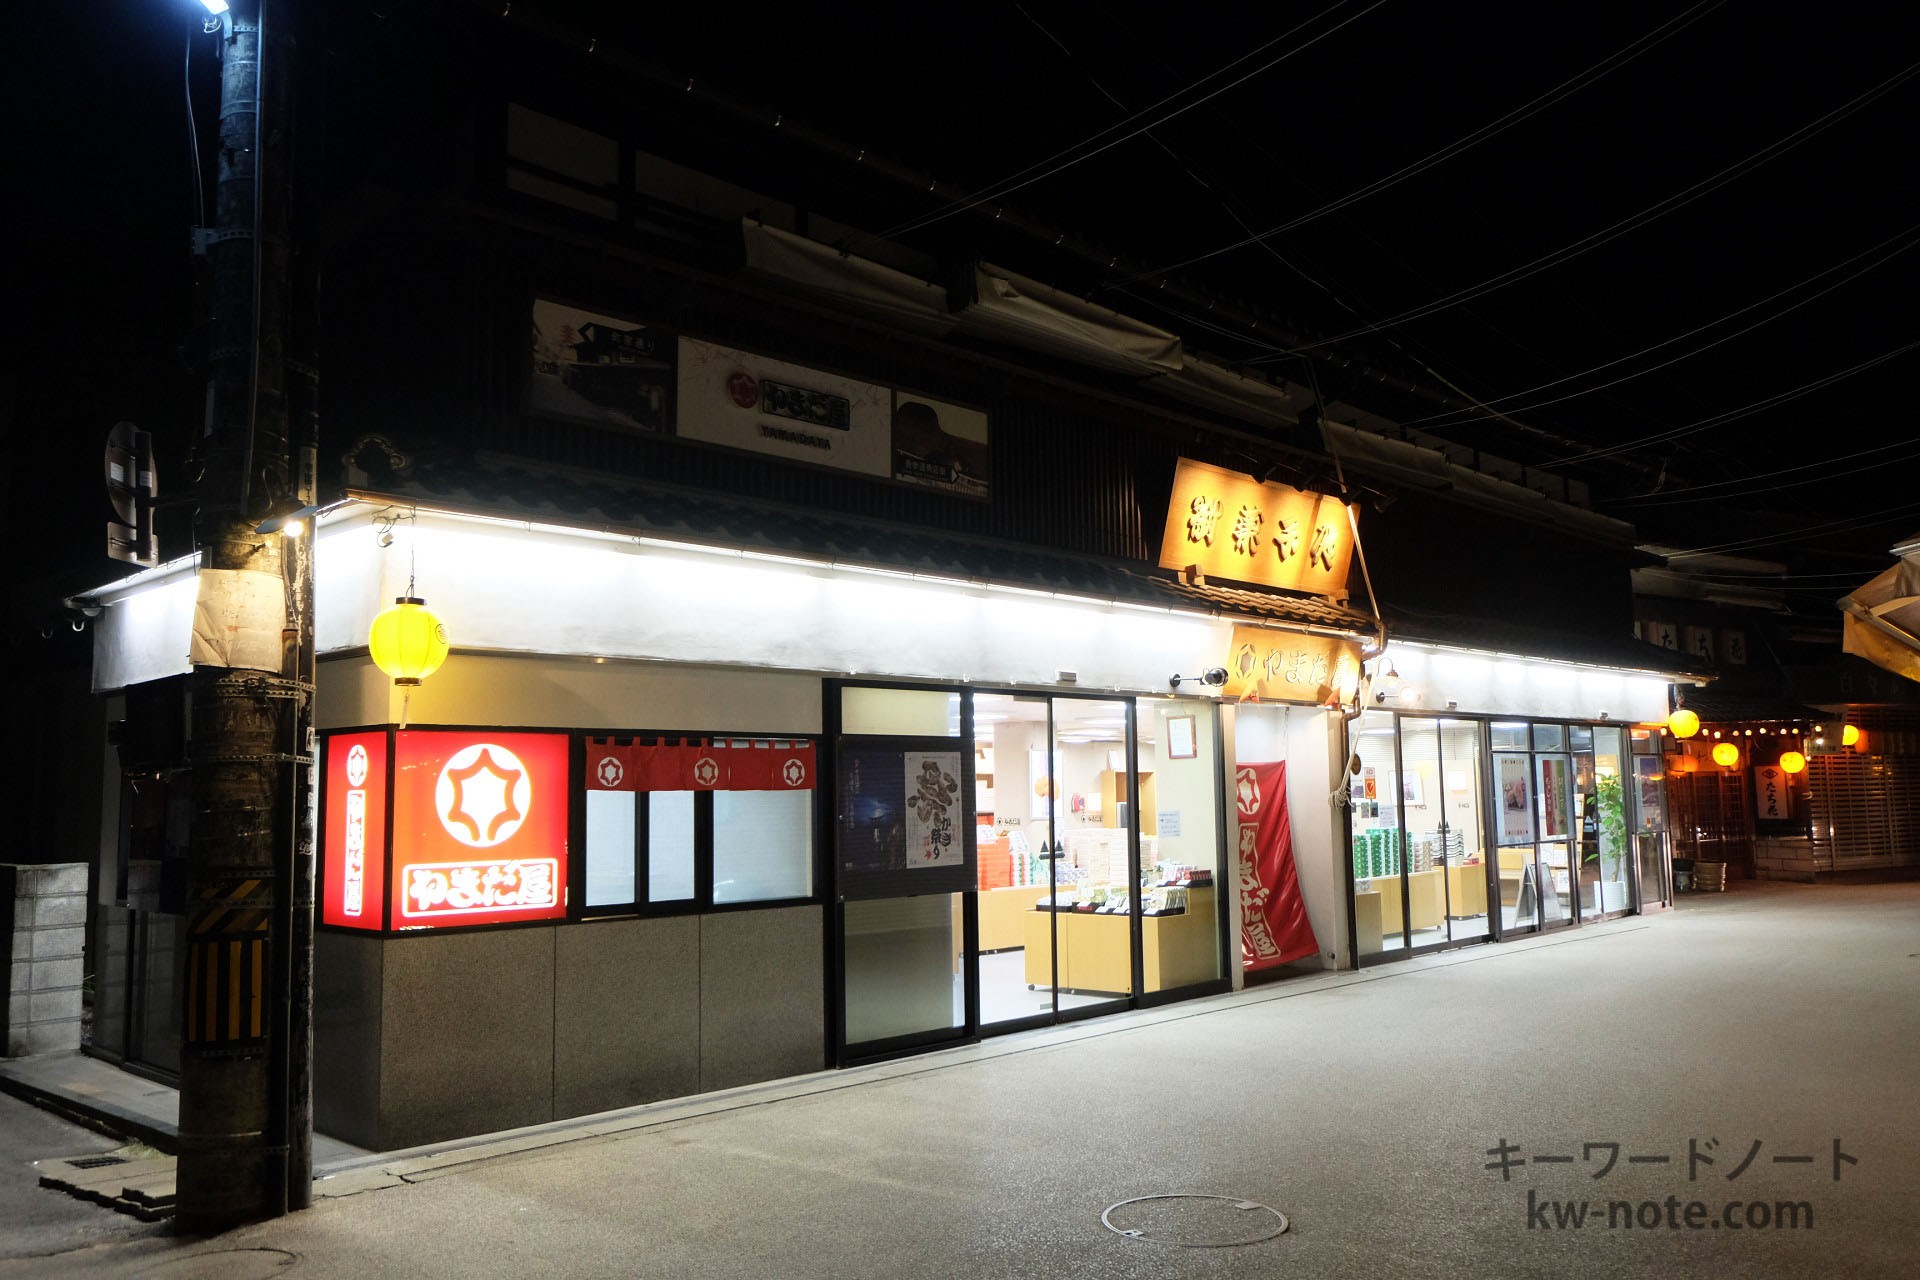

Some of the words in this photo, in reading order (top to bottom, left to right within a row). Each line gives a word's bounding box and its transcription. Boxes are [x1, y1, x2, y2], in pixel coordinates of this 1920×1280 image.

[409, 860, 553, 910] やまだ屋
[1240, 829, 1276, 956] やまだ屋
